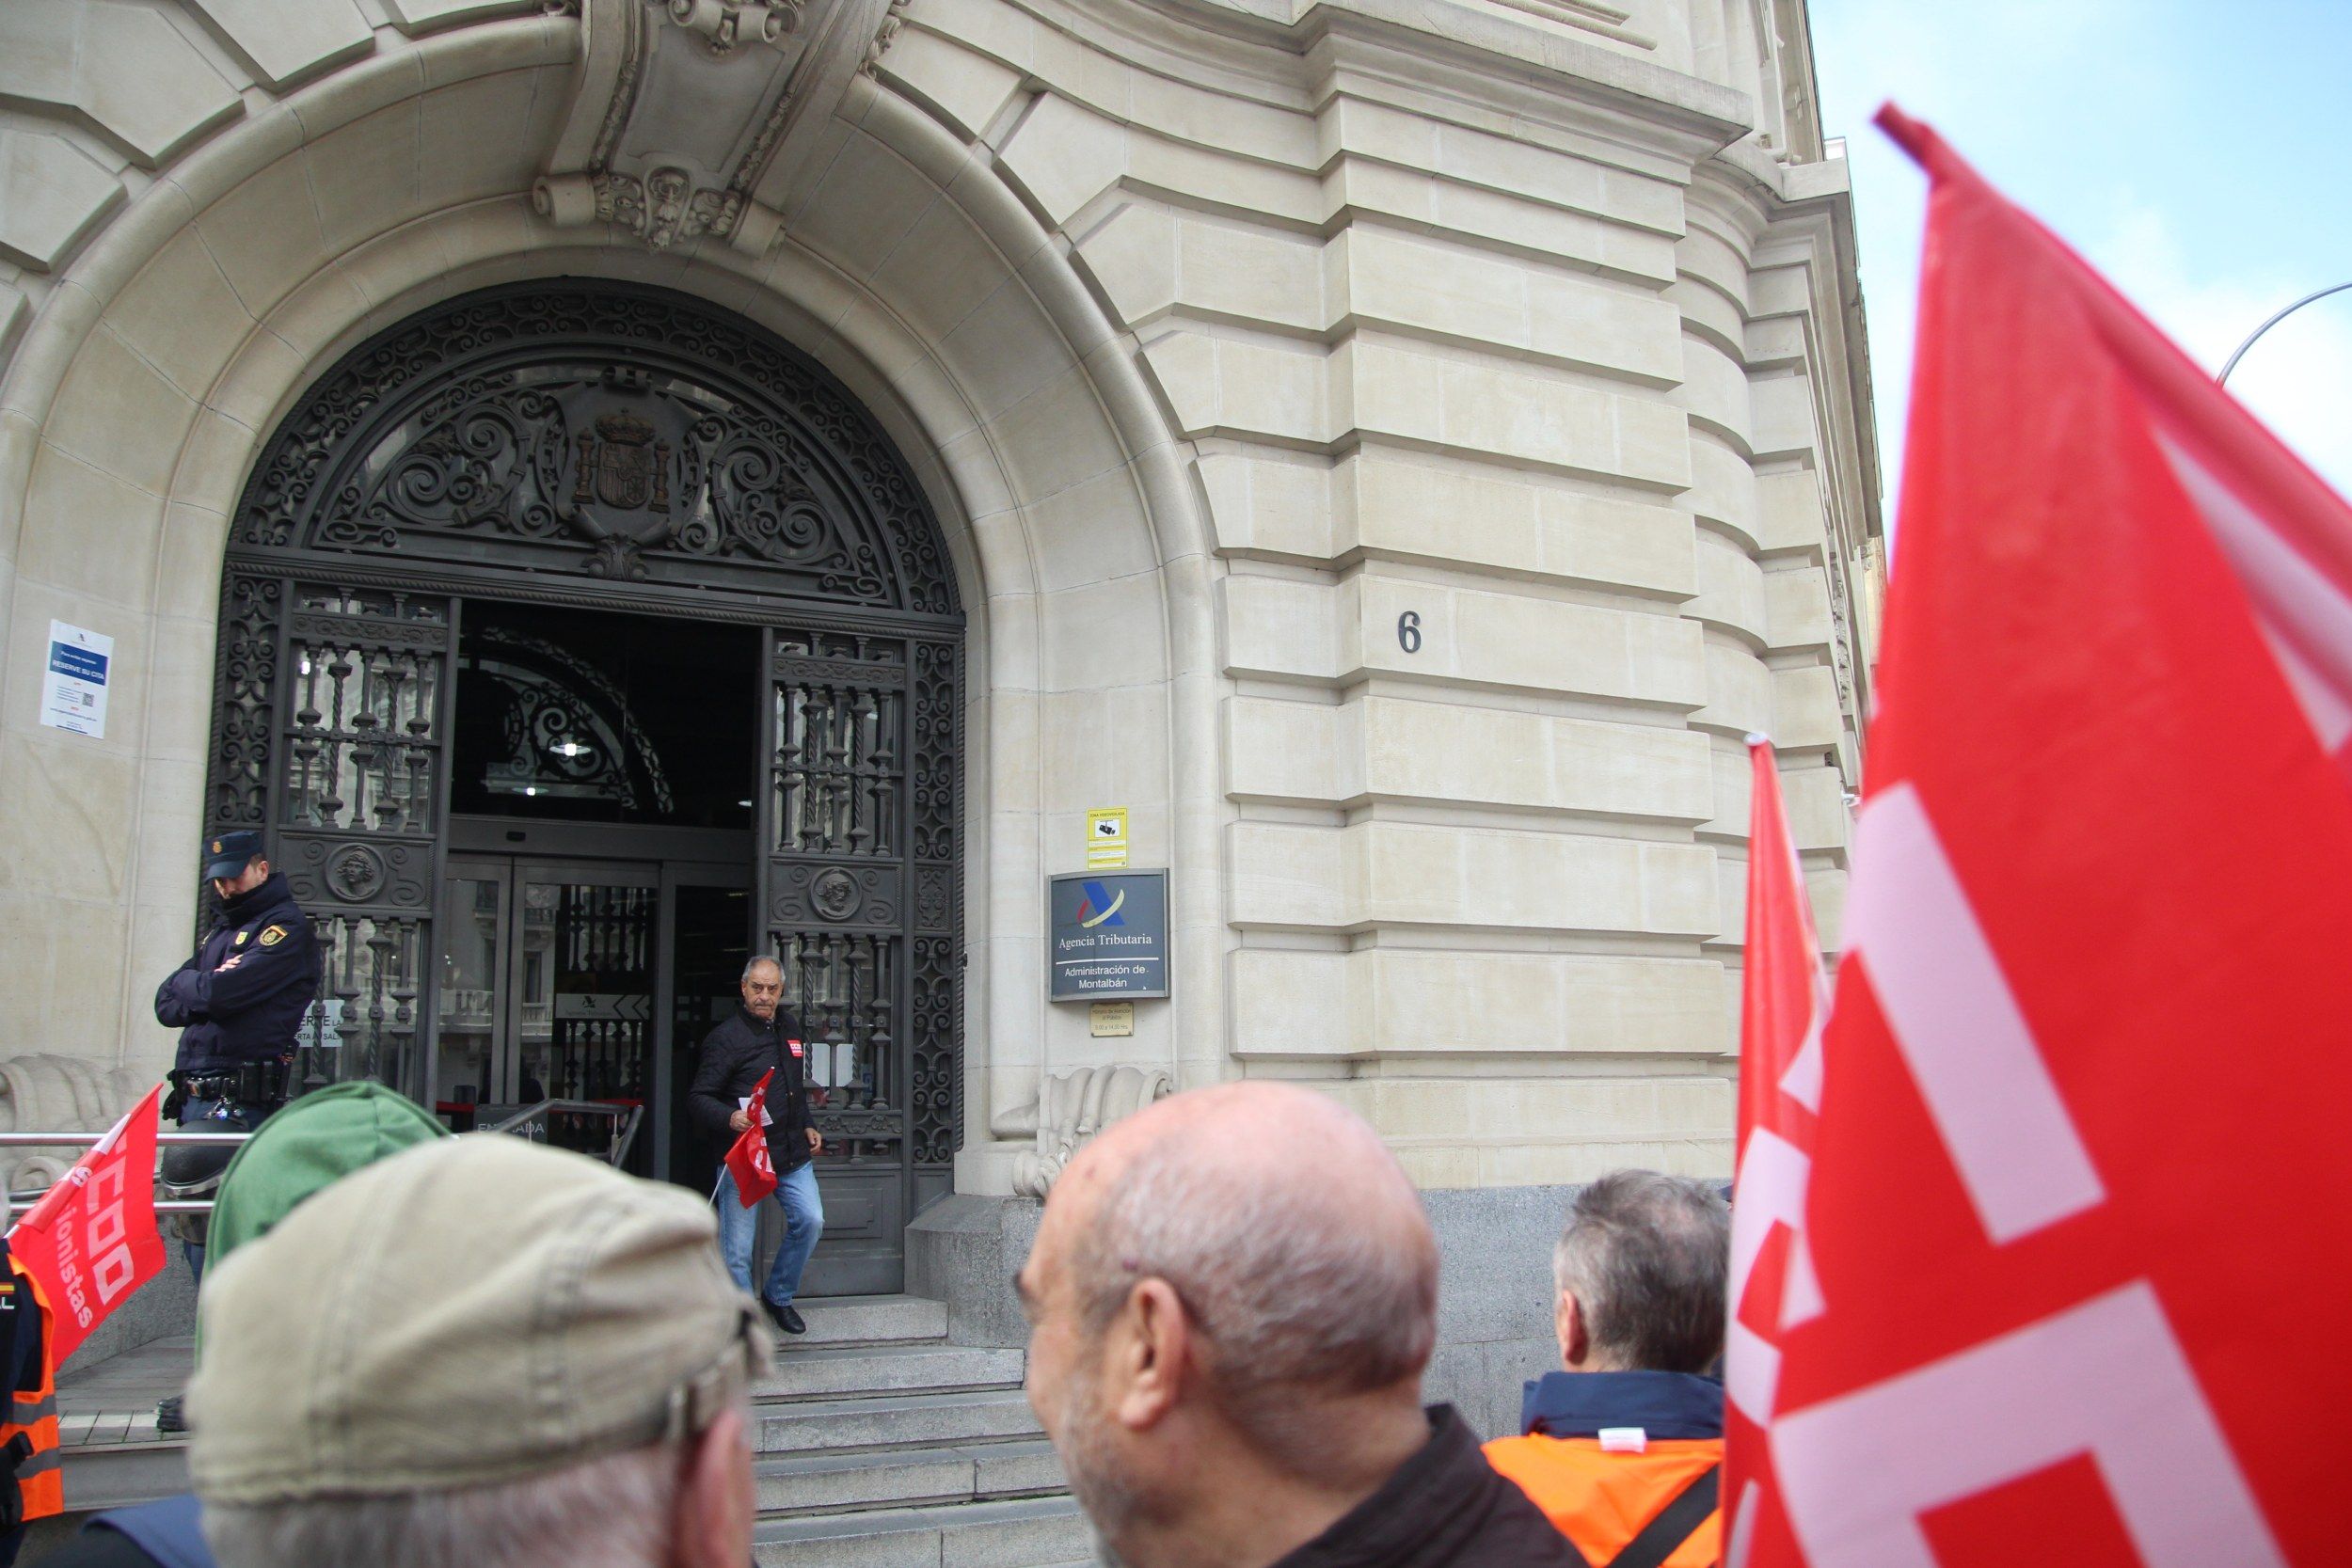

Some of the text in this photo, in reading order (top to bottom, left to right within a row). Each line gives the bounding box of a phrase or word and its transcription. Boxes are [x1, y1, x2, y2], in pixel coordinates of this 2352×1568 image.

[1398, 610, 1422, 654] 6
[52, 659, 82, 673] RESERVE
[1059, 933, 1152, 950] Agencia Tributaria
[1065, 964, 1146, 976] Administración de
[1078, 977, 1127, 989] Montalbán
[56, 1204, 94, 1329] ionistas
